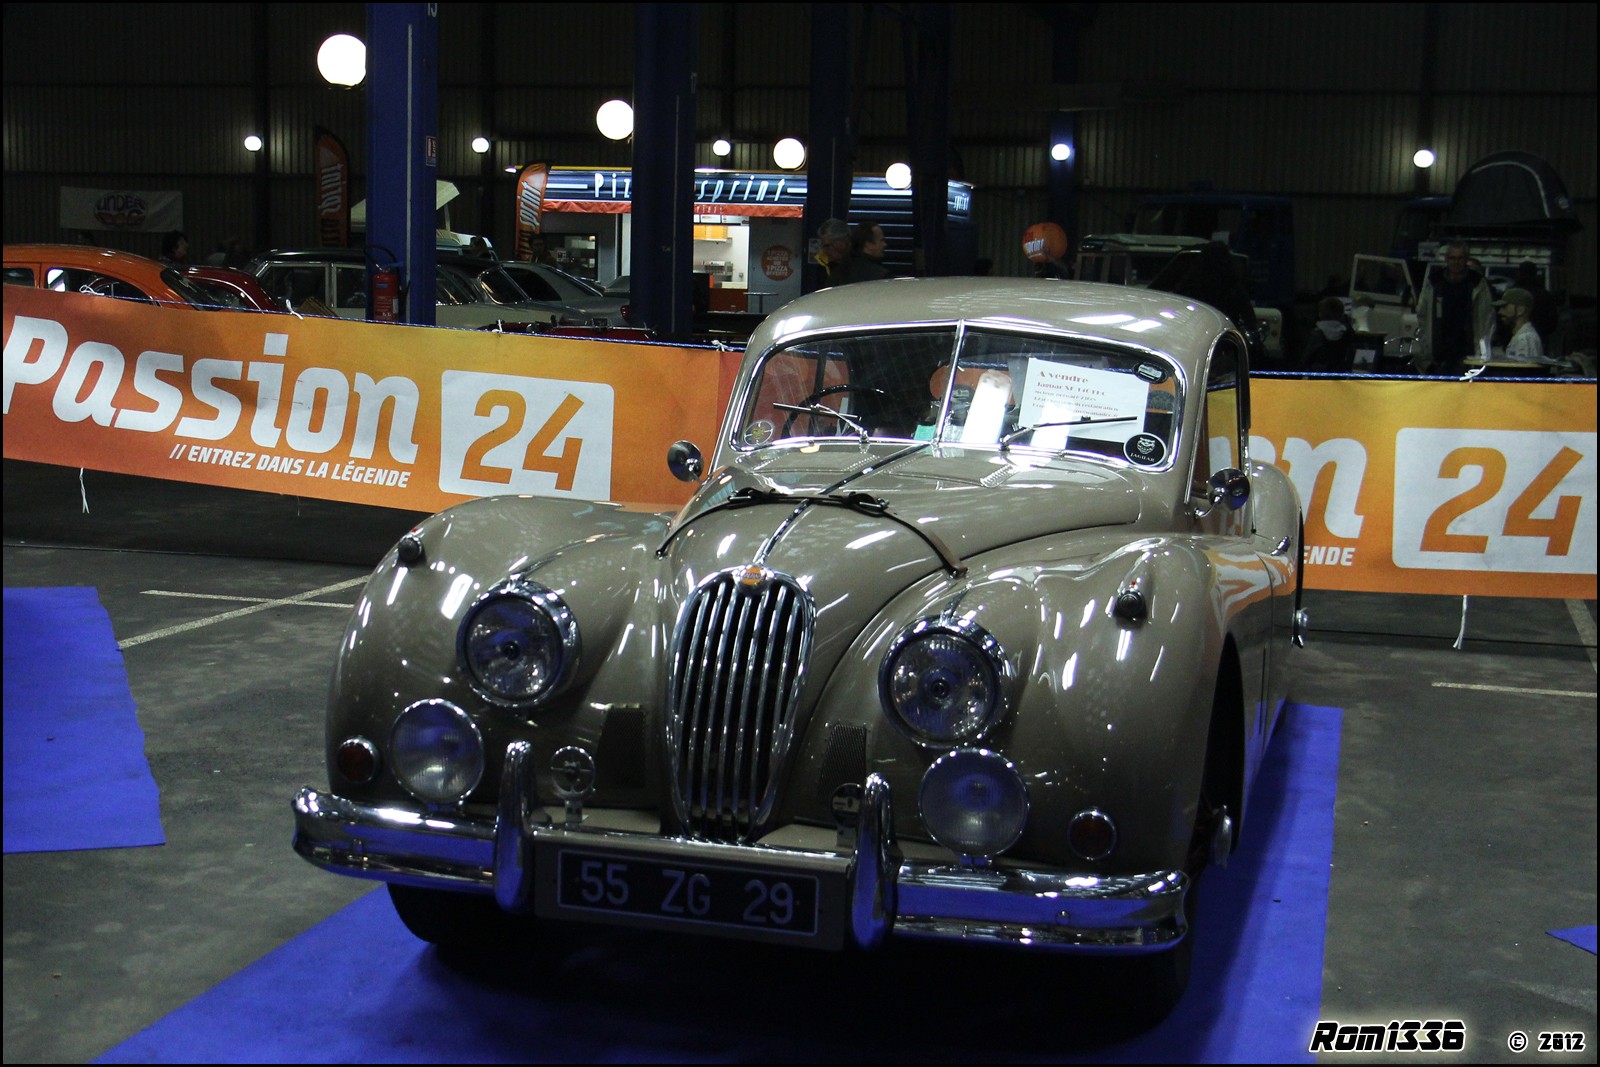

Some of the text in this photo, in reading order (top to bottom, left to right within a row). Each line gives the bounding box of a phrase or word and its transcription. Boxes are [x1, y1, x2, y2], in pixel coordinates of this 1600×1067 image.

[697, 178, 785, 202] sprint
[1048, 372, 1089, 384] vendre
[3, 315, 584, 491] Passion 24
[187, 445, 256, 469] ENTREZ
[256, 454, 303, 475] DANS
[305, 461, 328, 478] LA
[331, 460, 411, 488] LÉGENDE
[1130, 452, 1155, 463] JAGUAR
[1419, 446, 1584, 556] 24
[580, 860, 794, 925] 55 ZG 29
